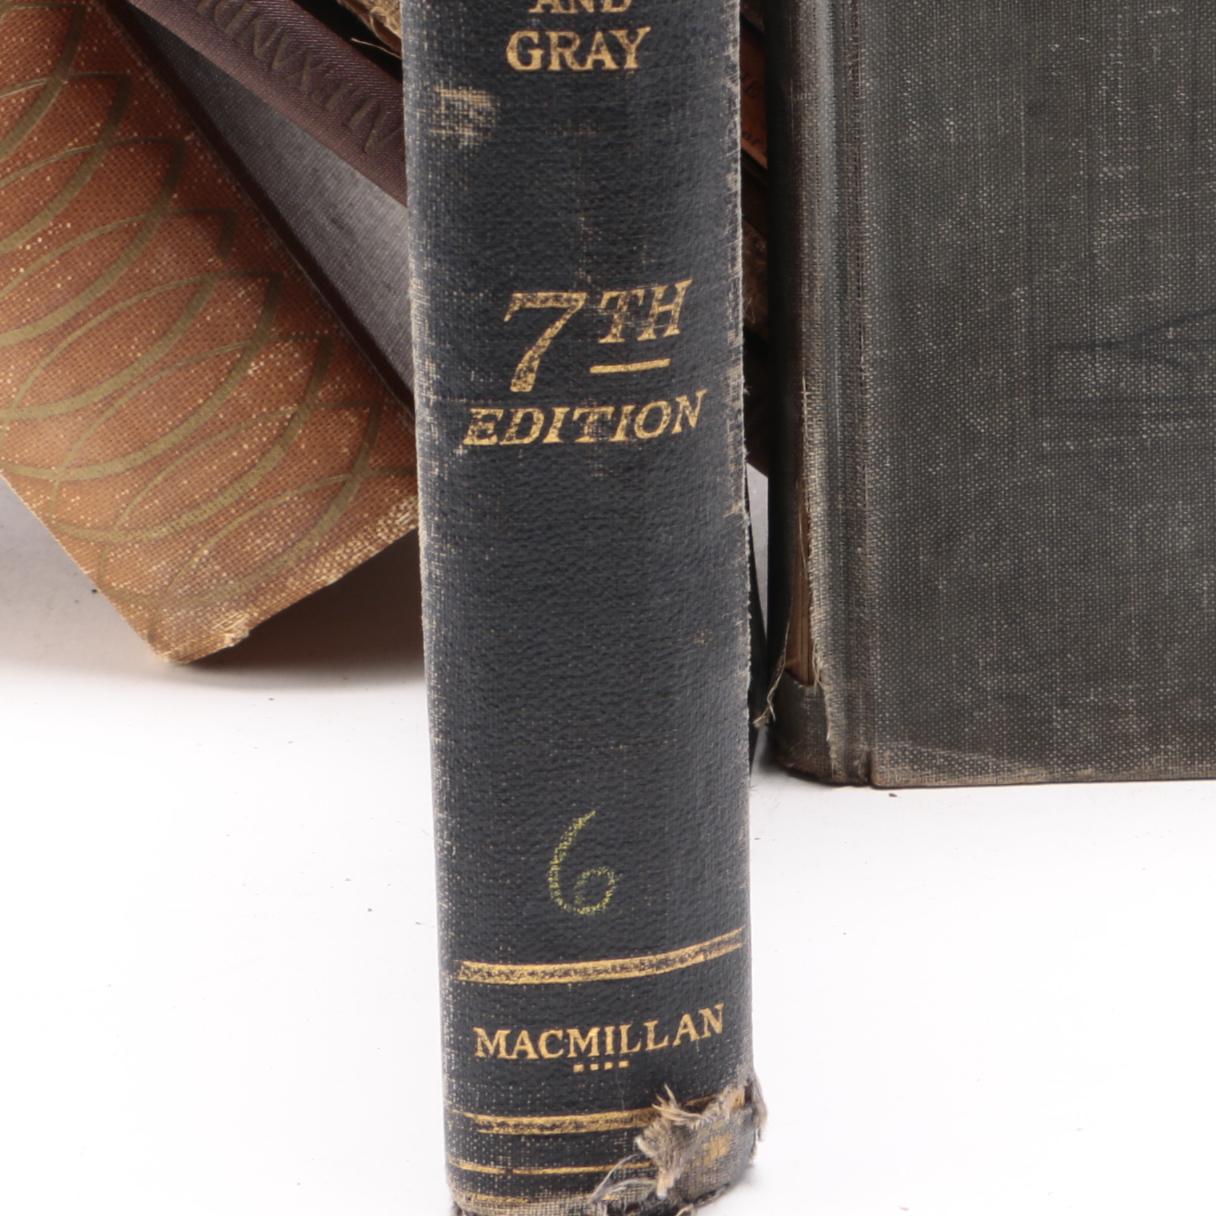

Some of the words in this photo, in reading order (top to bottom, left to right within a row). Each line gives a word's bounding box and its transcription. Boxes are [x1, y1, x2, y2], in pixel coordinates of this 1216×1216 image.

[505, 26, 652, 72] GRAY
[462, 388, 709, 446] EDITION
[547, 810, 622, 915] 6
[472, 1003, 726, 1061] MACMILLAN
